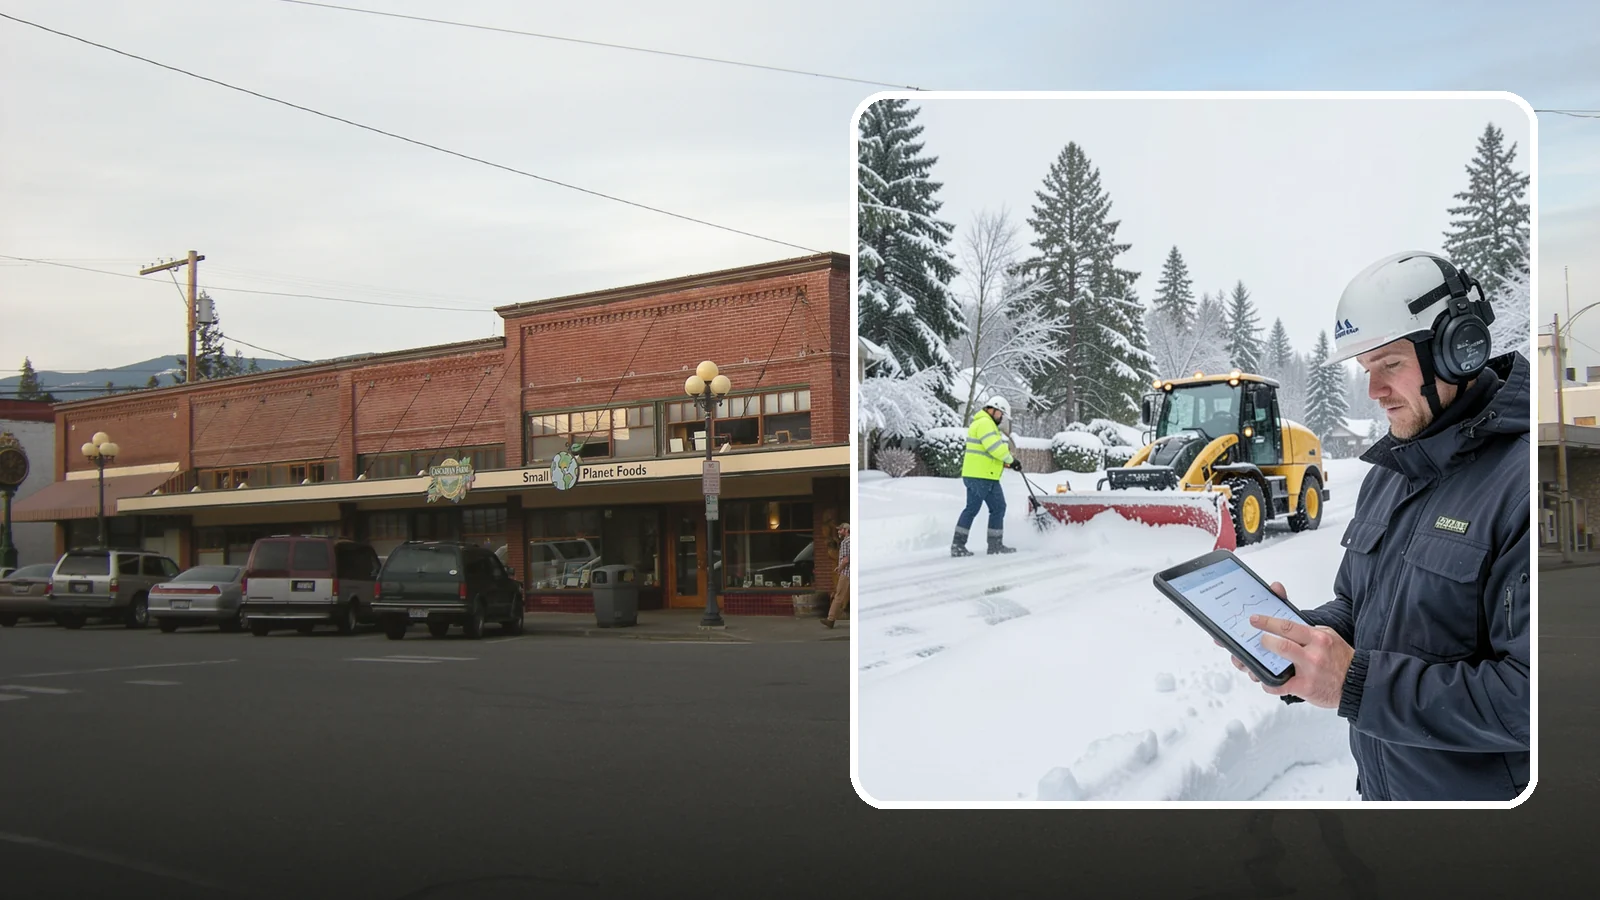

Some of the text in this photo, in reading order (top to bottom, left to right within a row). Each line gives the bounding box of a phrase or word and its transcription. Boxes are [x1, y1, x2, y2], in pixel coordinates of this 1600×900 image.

[431, 466, 469, 476] CASCADIAN FARM
[523, 464, 647, 483] Small Planet Foods
